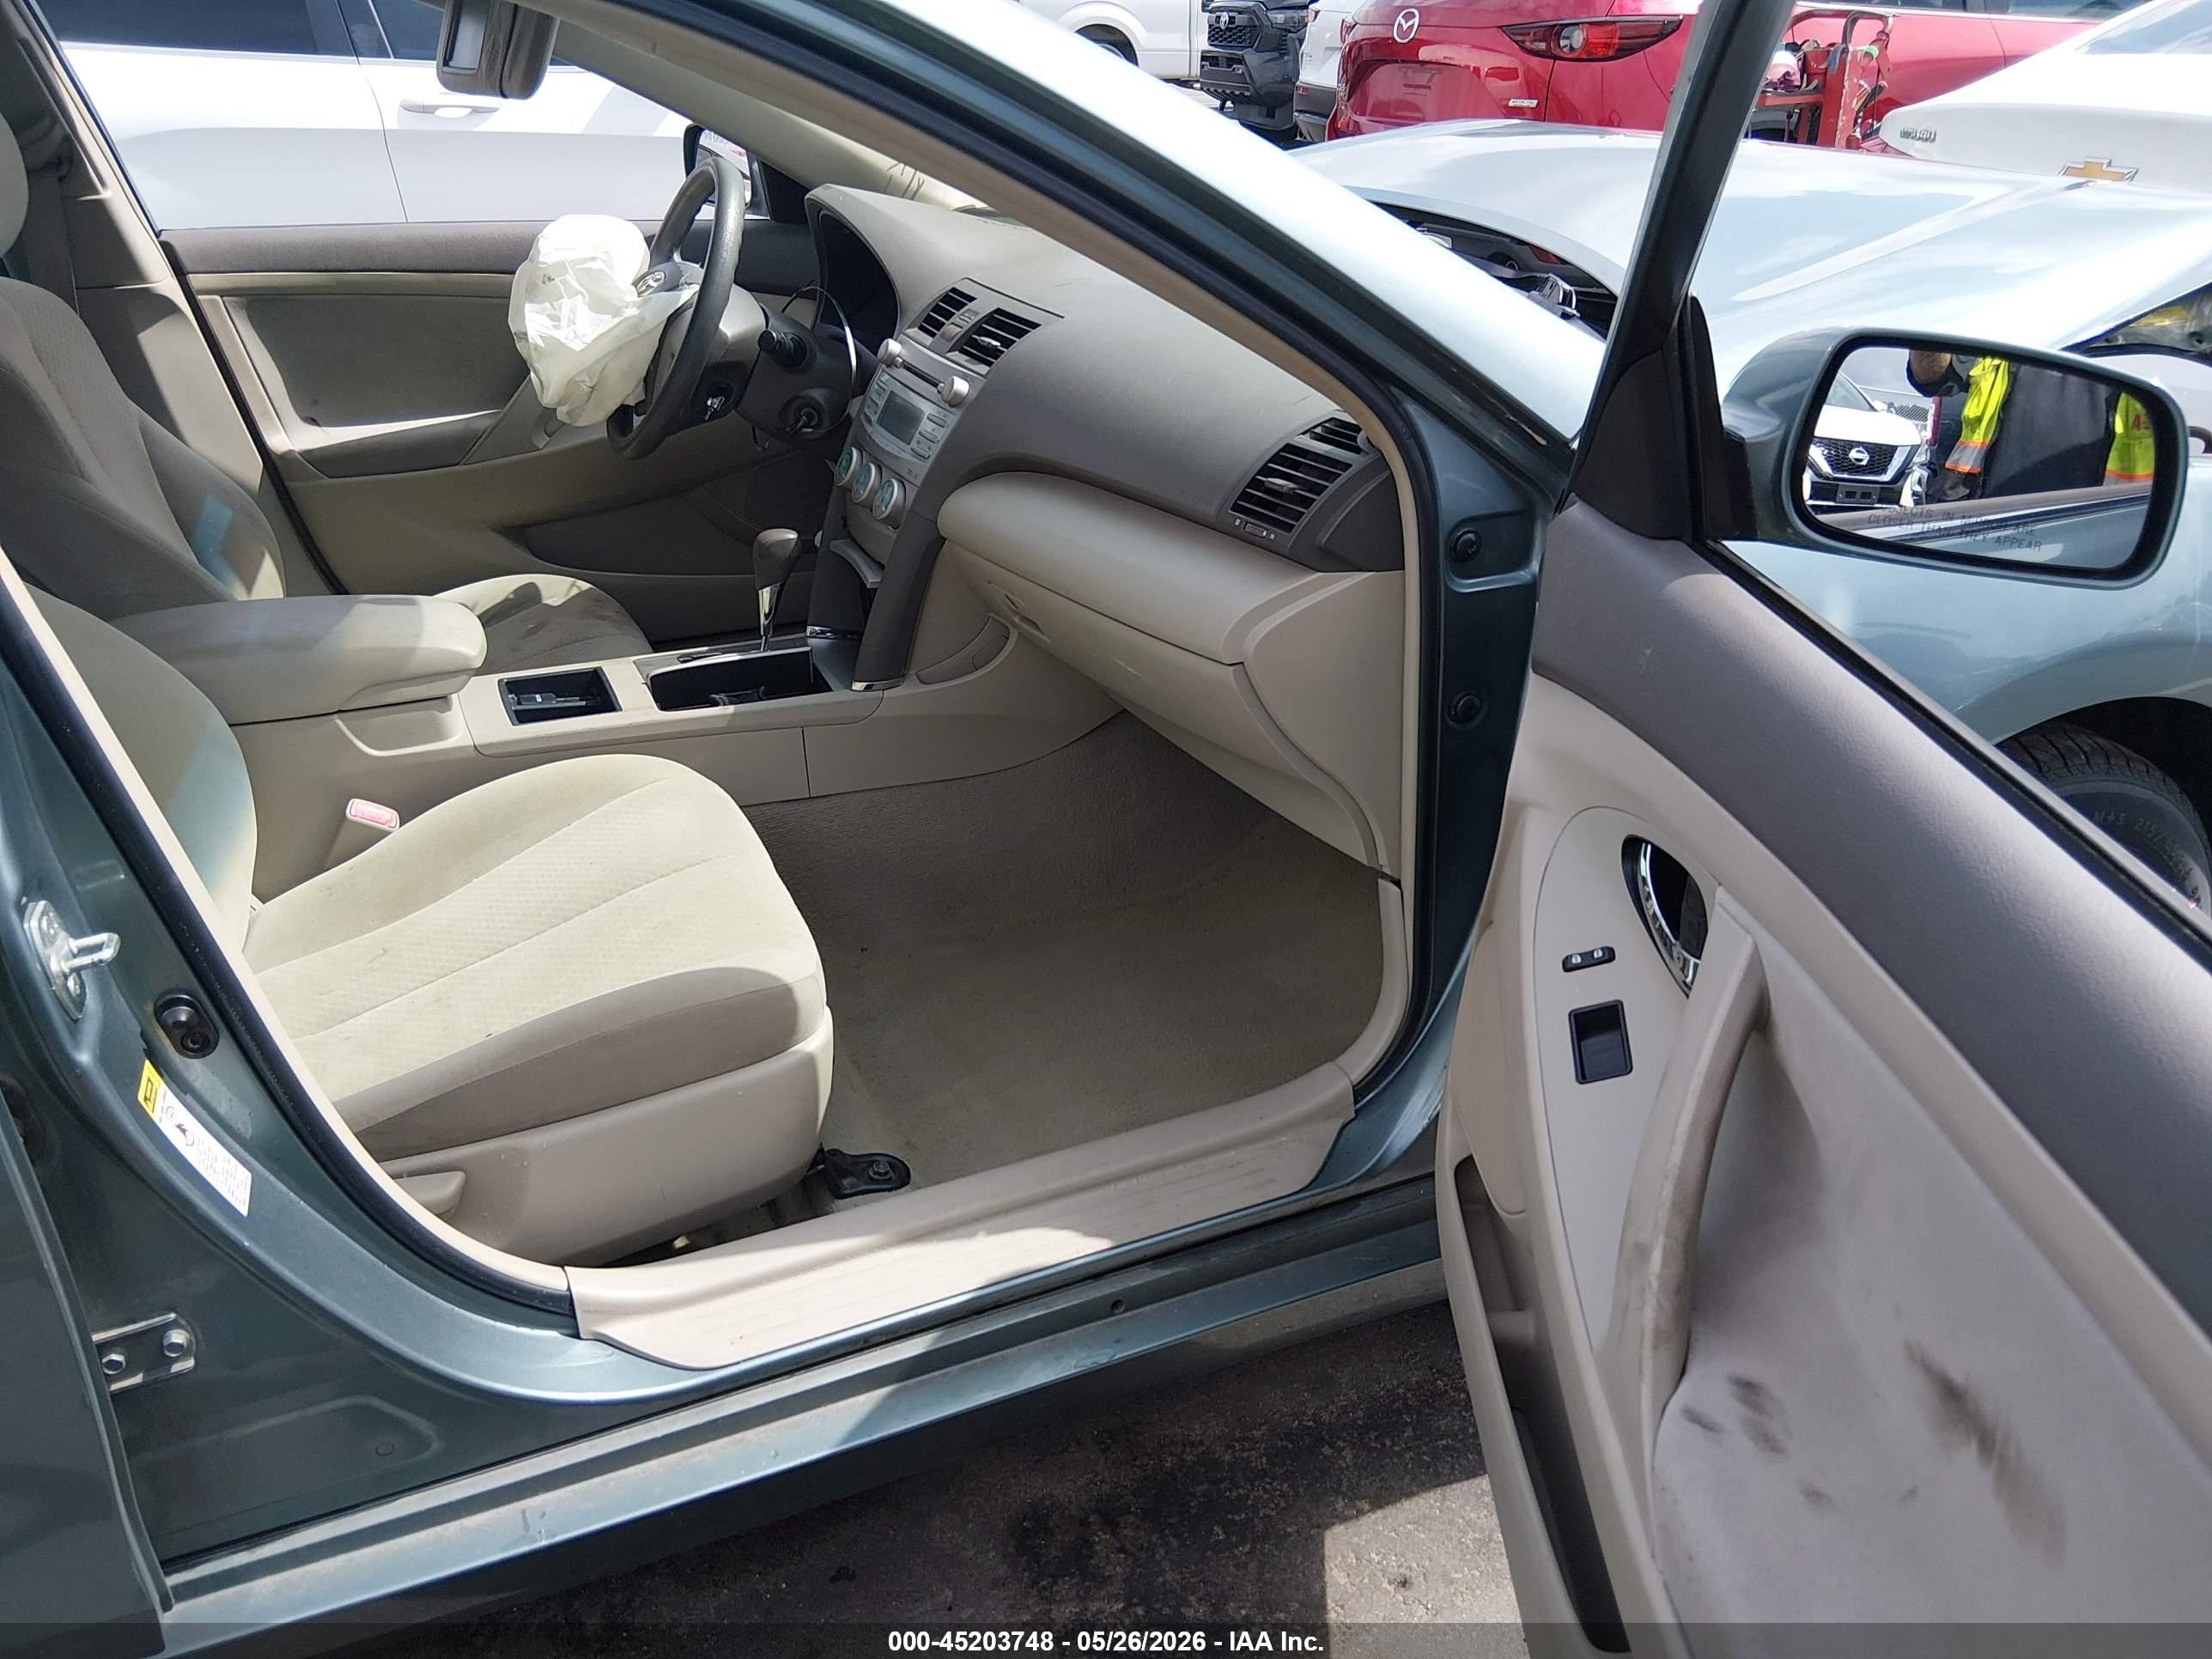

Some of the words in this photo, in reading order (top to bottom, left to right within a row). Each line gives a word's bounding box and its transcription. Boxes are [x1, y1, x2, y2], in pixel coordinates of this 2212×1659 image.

[1883, 506, 1933, 519] BJECTS
[1942, 511, 1955, 520] IN
[1869, 514, 1915, 530] CLOSER
[1995, 535, 2042, 551] APPEAR
